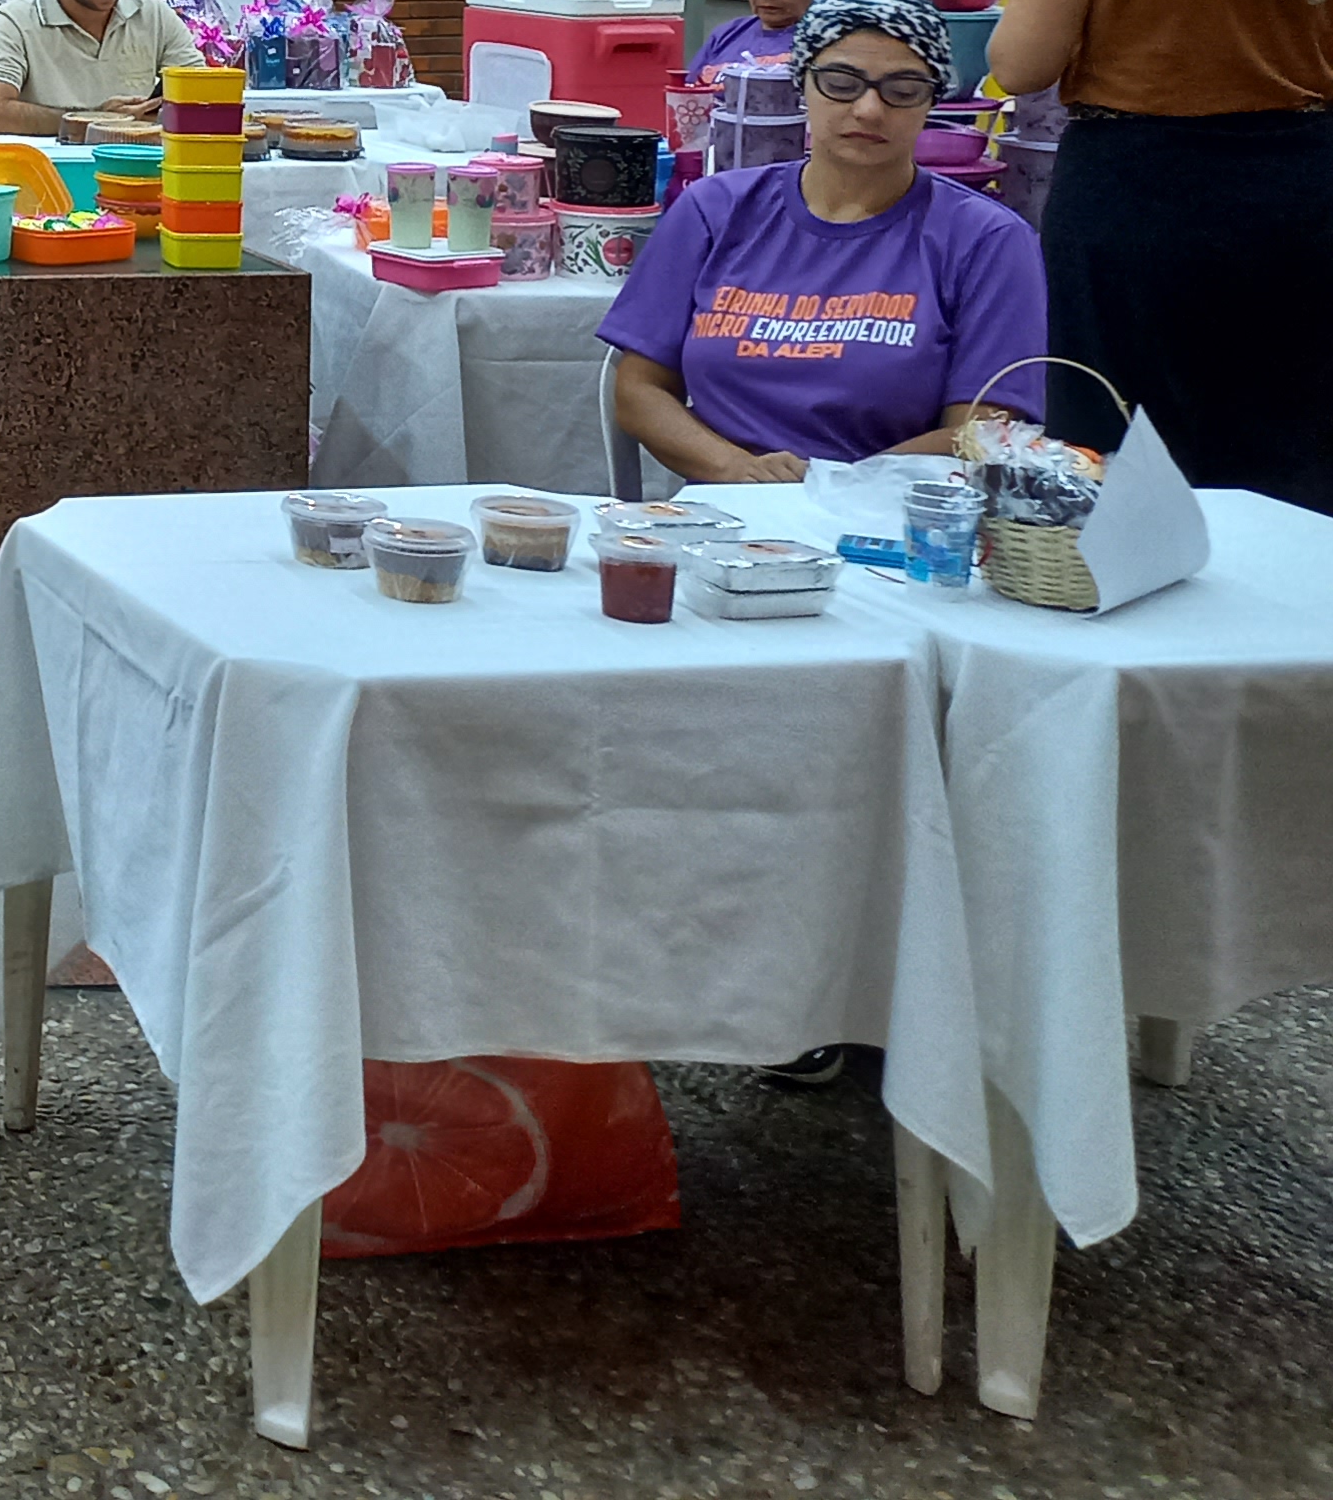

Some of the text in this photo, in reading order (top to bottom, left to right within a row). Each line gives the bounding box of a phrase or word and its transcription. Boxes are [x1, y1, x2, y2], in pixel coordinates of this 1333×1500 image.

[712, 286, 917, 321] EIRINHA DO SERVIDOR
[750, 317, 917, 348] EMPREENDEDOR
[736, 340, 844, 359] DA ALEPI
